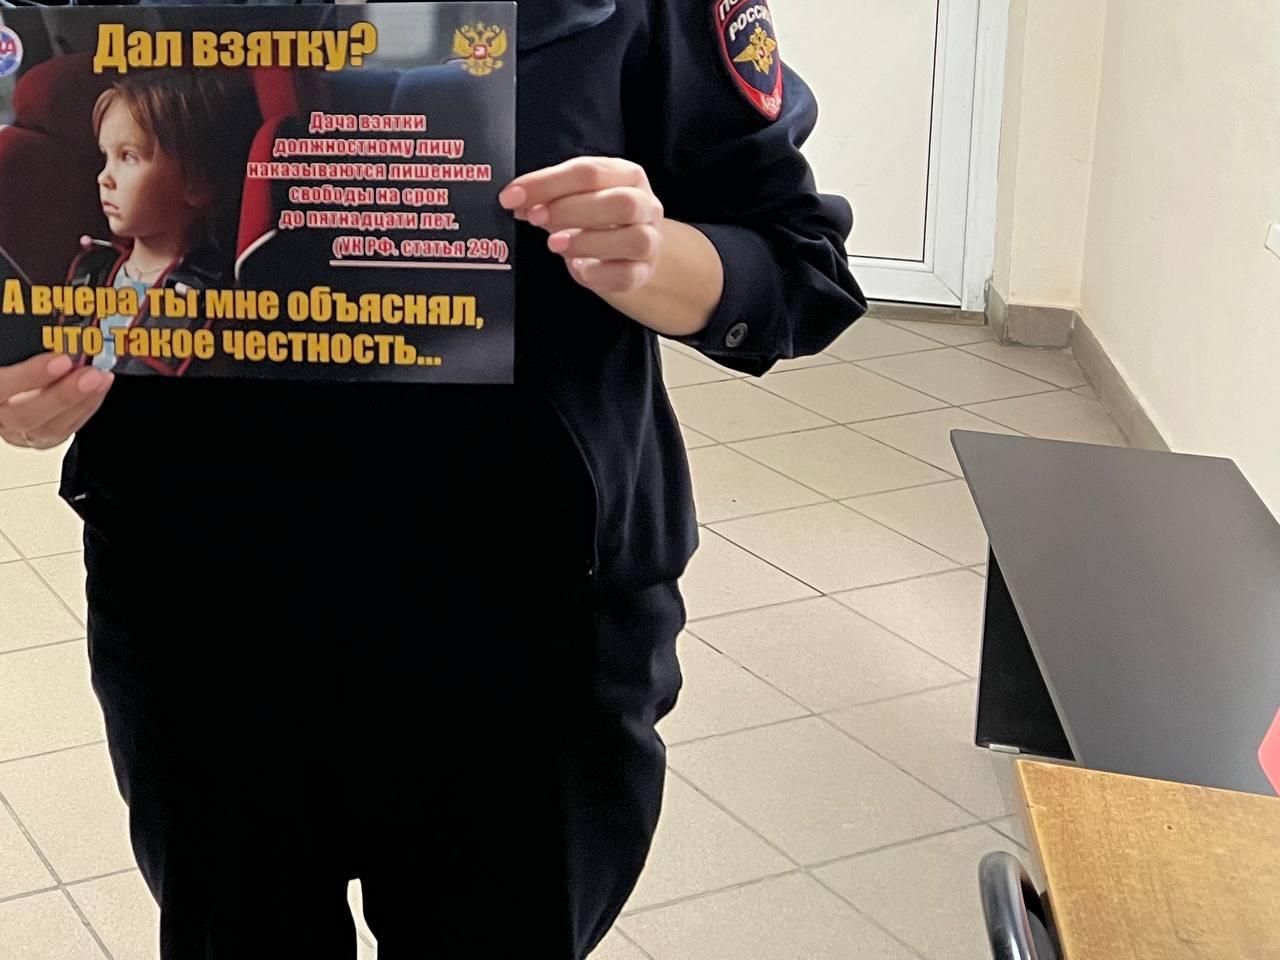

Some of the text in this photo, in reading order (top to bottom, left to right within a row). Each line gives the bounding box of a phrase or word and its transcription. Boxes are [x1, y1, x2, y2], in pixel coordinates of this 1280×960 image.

[92, 21, 378, 74] Дал взятку?
[308, 111, 426, 134] Дача взятки
[272, 138, 465, 158] должностному лицу
[246, 161, 492, 182] наказываются лишением
[288, 183, 449, 207] свободы на срок
[278, 210, 460, 231] до пятнадцати лет.
[332, 236, 509, 263] (УК РФ. статья 291)
[1, 278, 485, 330] А вчера ты мне объяснял,
[42, 325, 442, 366] что такое честность...
